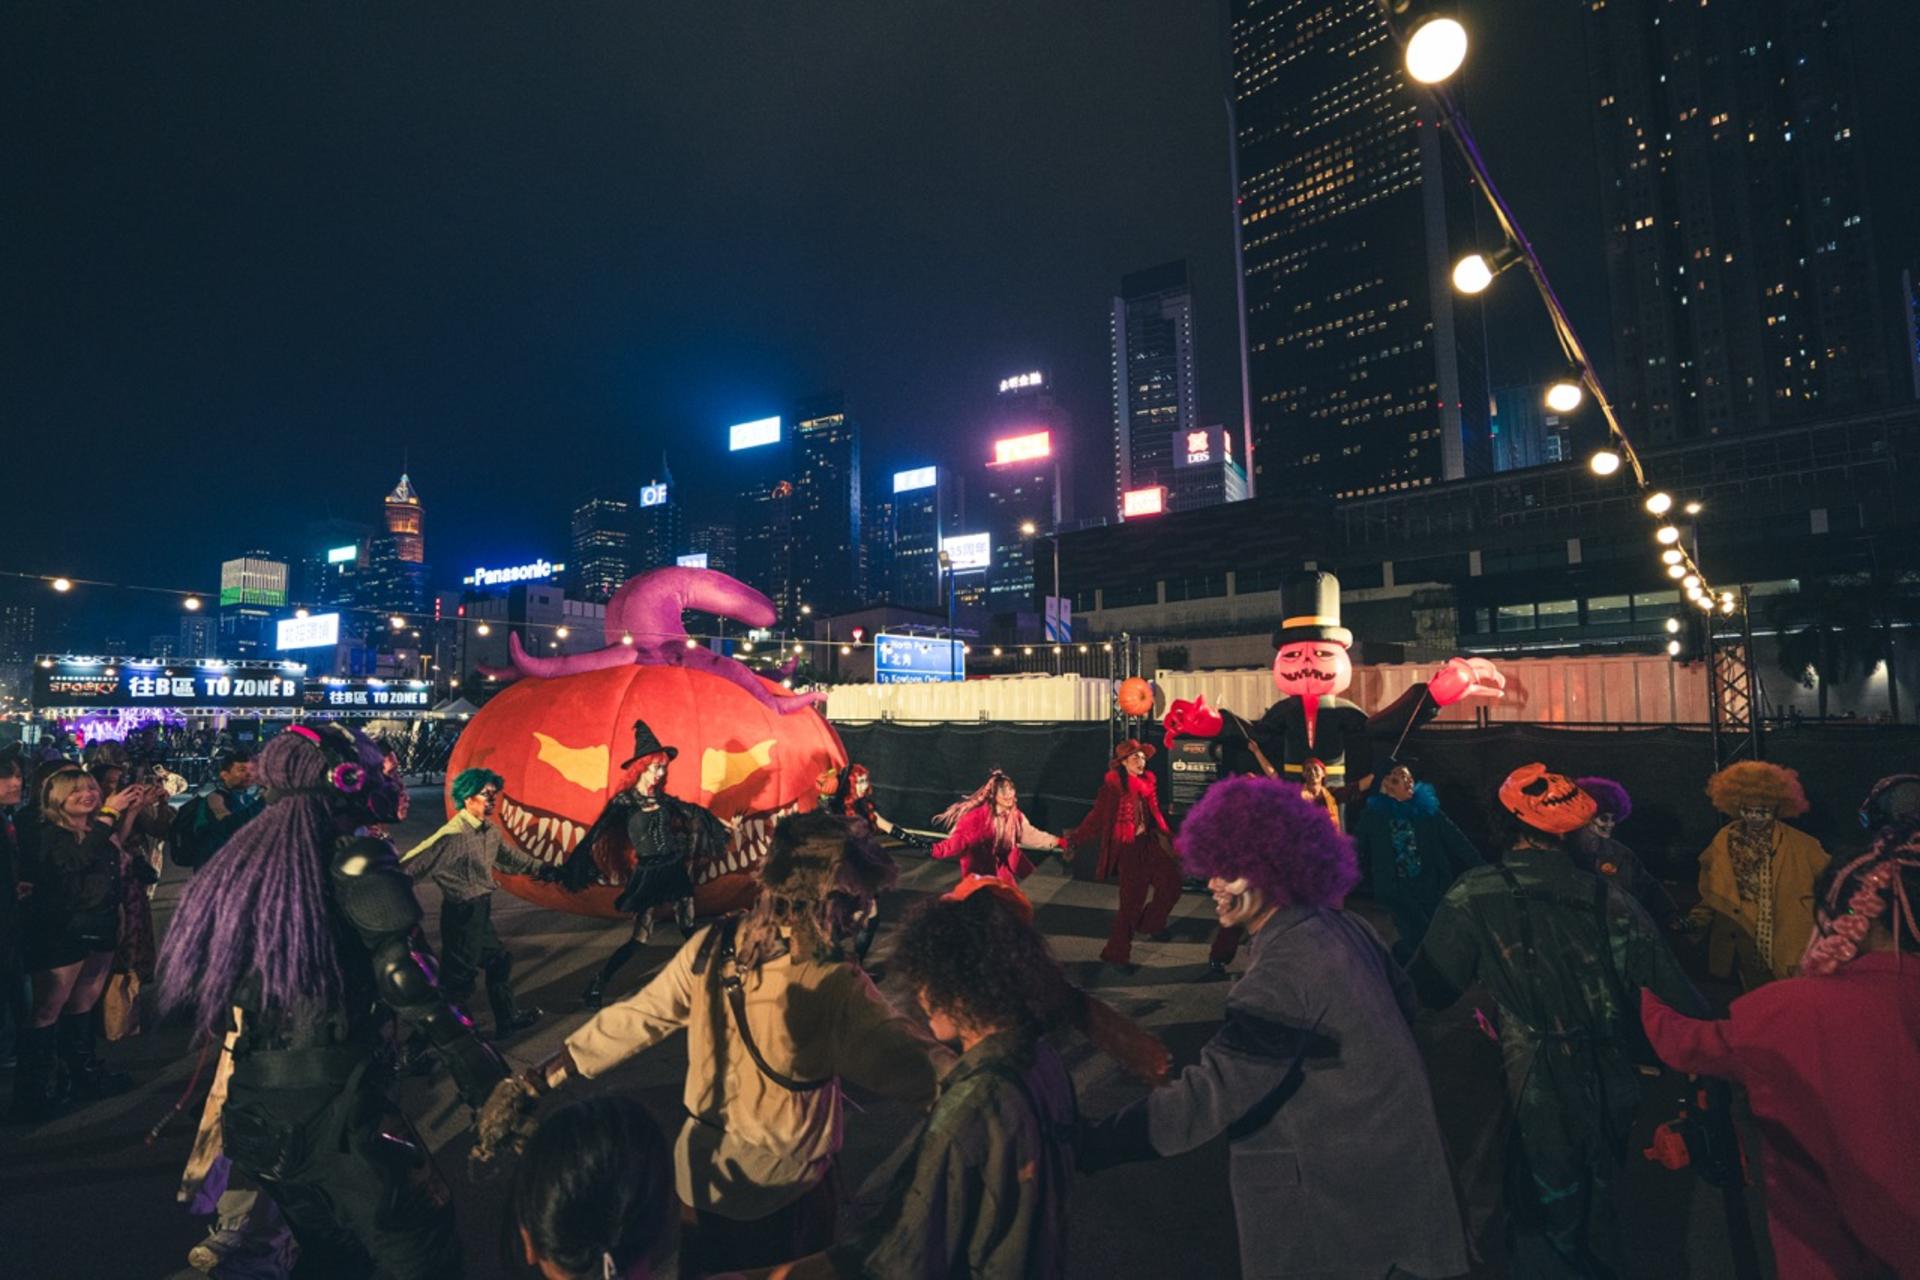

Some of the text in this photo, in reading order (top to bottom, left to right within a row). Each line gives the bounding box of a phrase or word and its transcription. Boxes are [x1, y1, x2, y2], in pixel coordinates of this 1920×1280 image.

[1187, 452, 1210, 464] DBS
[475, 558, 551, 586] Panasonic
[129, 676, 296, 697] 往B區 TO ZONE B
[329, 691, 368, 704] 往B區
[373, 692, 388, 704] TO
[390, 692, 418, 704] ZONE
[420, 692, 428, 704] B
